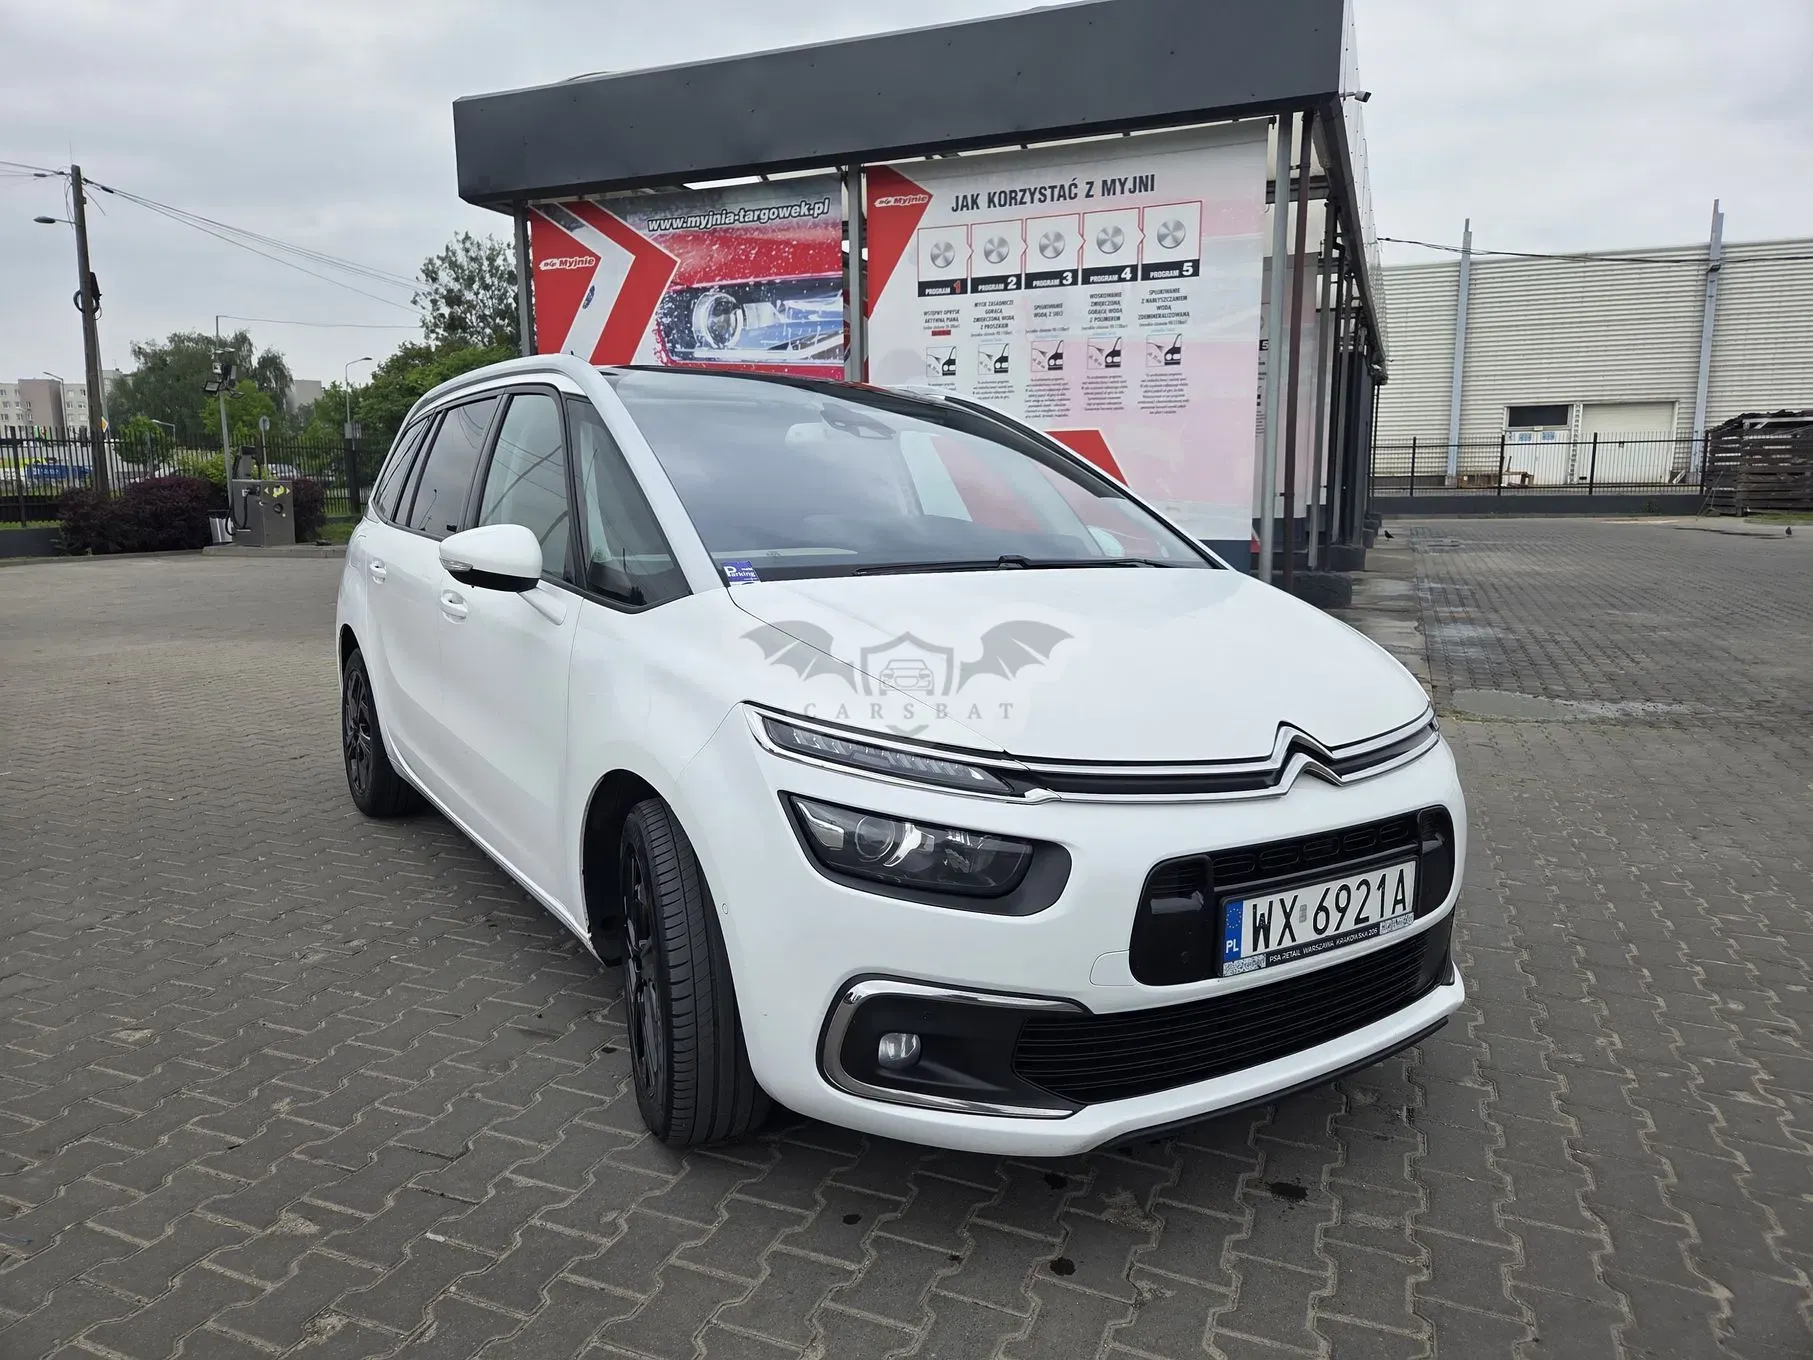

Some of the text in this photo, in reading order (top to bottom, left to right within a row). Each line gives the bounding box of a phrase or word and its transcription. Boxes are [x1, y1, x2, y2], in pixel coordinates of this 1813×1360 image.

[951, 174, 1156, 213] JAK KORZYSTAĆ Z MYJNI
[648, 199, 830, 232] www.myjnia-targowek.pl
[558, 257, 595, 268] Myjnie
[1149, 262, 1193, 279] PROGRAM 5
[1032, 271, 1073, 287] PROGRAM 3
[1089, 267, 1132, 282] PROGRAM 4
[953, 280, 961, 294] 1
[978, 276, 1017, 291] PROGRAM 2
[1252, 868, 1407, 953] WX 6921A
[1225, 940, 1239, 954] PL
[1269, 928, 1378, 963] PSA RETAIL WARSZAWA KRAKOWSKA 206
